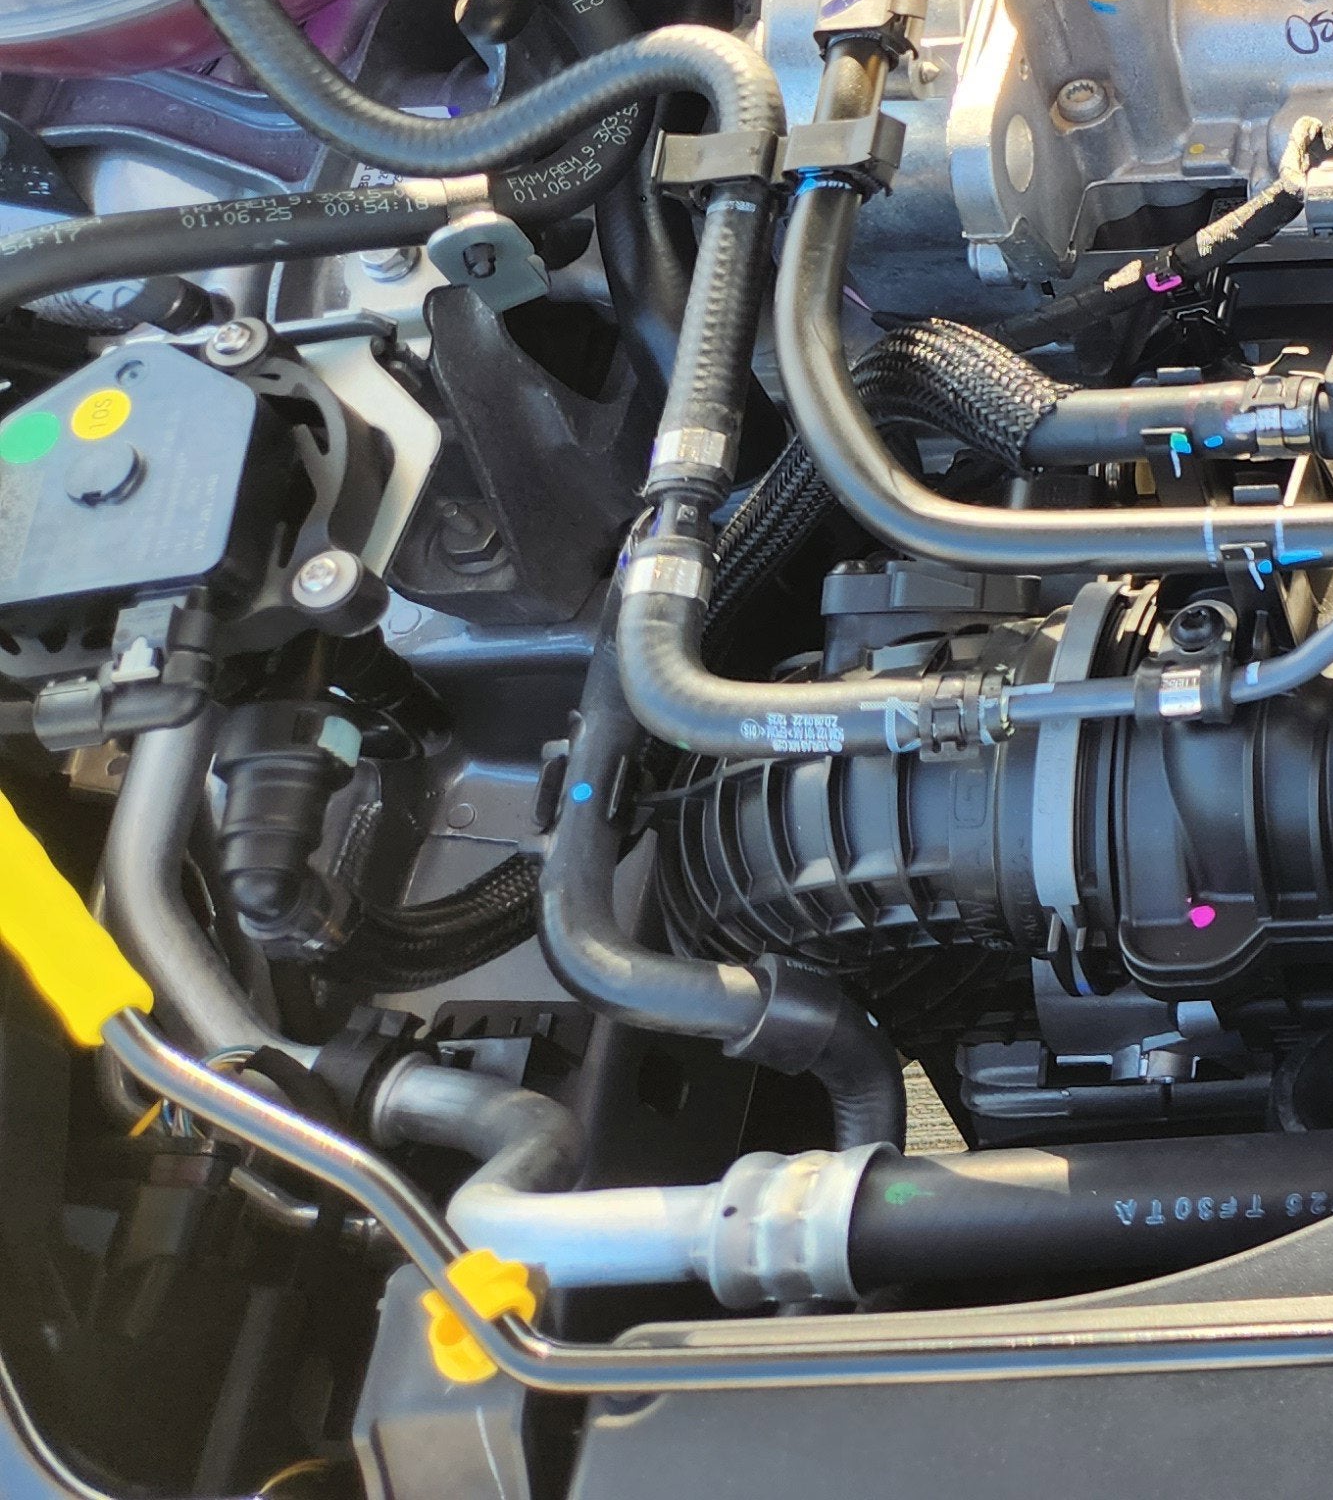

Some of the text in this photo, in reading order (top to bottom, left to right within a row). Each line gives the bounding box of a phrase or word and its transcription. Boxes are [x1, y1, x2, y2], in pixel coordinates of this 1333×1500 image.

[514, 102, 639, 203] 01.06.25 00:5
[506, 155, 583, 189] FKM/AEM
[182, 207, 292, 229] 01.06.25
[1114, 1193, 1266, 1225] TF30TA
